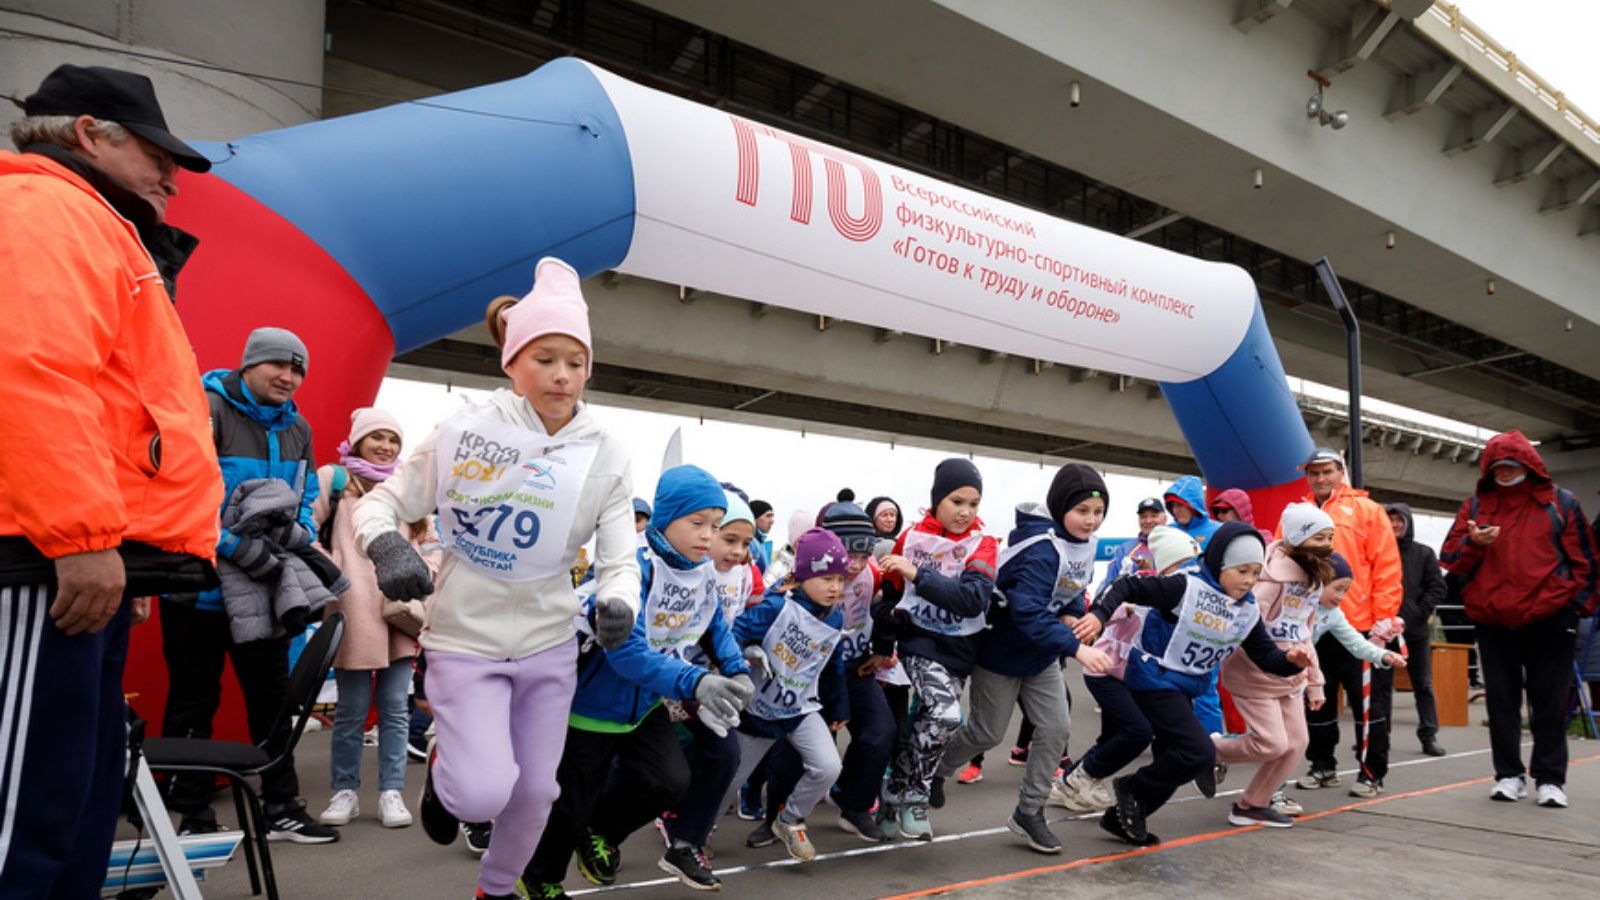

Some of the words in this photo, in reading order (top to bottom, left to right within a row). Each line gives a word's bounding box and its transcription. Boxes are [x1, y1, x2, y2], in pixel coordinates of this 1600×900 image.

[891, 174, 1037, 239] Всероссийский
[892, 236, 959, 275] «Готов
[963, 262, 975, 280] к
[979, 266, 1028, 301] труду
[1031, 285, 1044, 302] и
[1046, 290, 1121, 324] обороне»
[896, 201, 1129, 298] физкультурно-спортивный
[1131, 286, 1197, 319] комплекс
